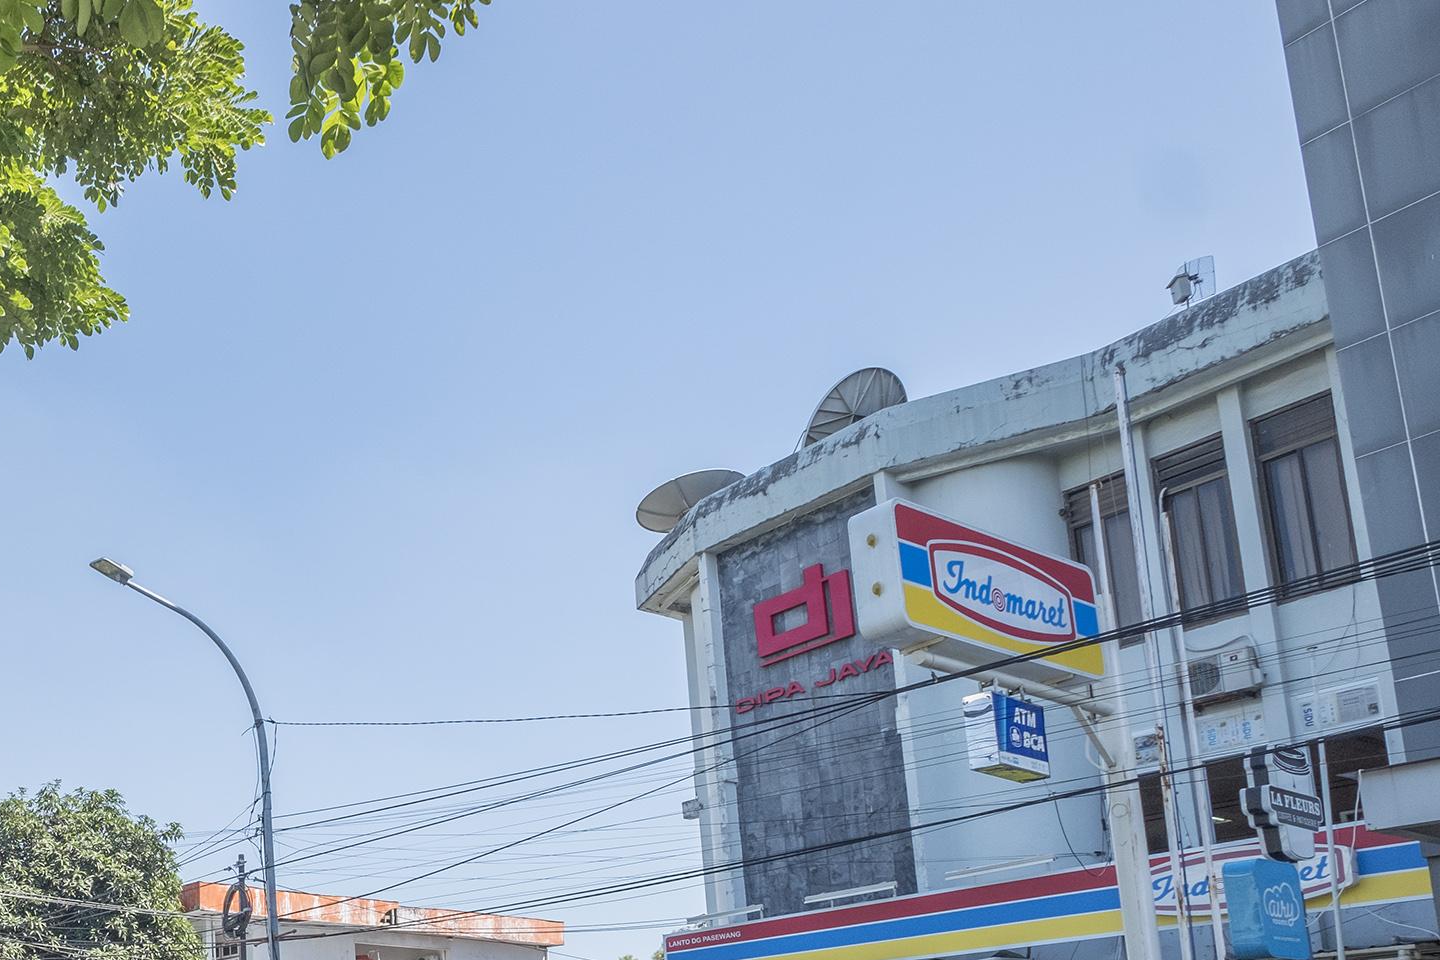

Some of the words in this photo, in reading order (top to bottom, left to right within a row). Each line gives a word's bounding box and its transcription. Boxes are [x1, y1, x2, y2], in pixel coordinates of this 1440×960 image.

[943, 561, 1067, 628] Indomaret
[736, 681, 806, 714] DIPA
[815, 652, 894, 688] JAYA
[1013, 707, 1036, 729] ATM
[1023, 731, 1046, 753] BCA
[1270, 791, 1283, 806] LA
[1283, 795, 1321, 816] FLEURS
[668, 938, 691, 948] LANTO
[702, 931, 741, 943] PASEWANG
